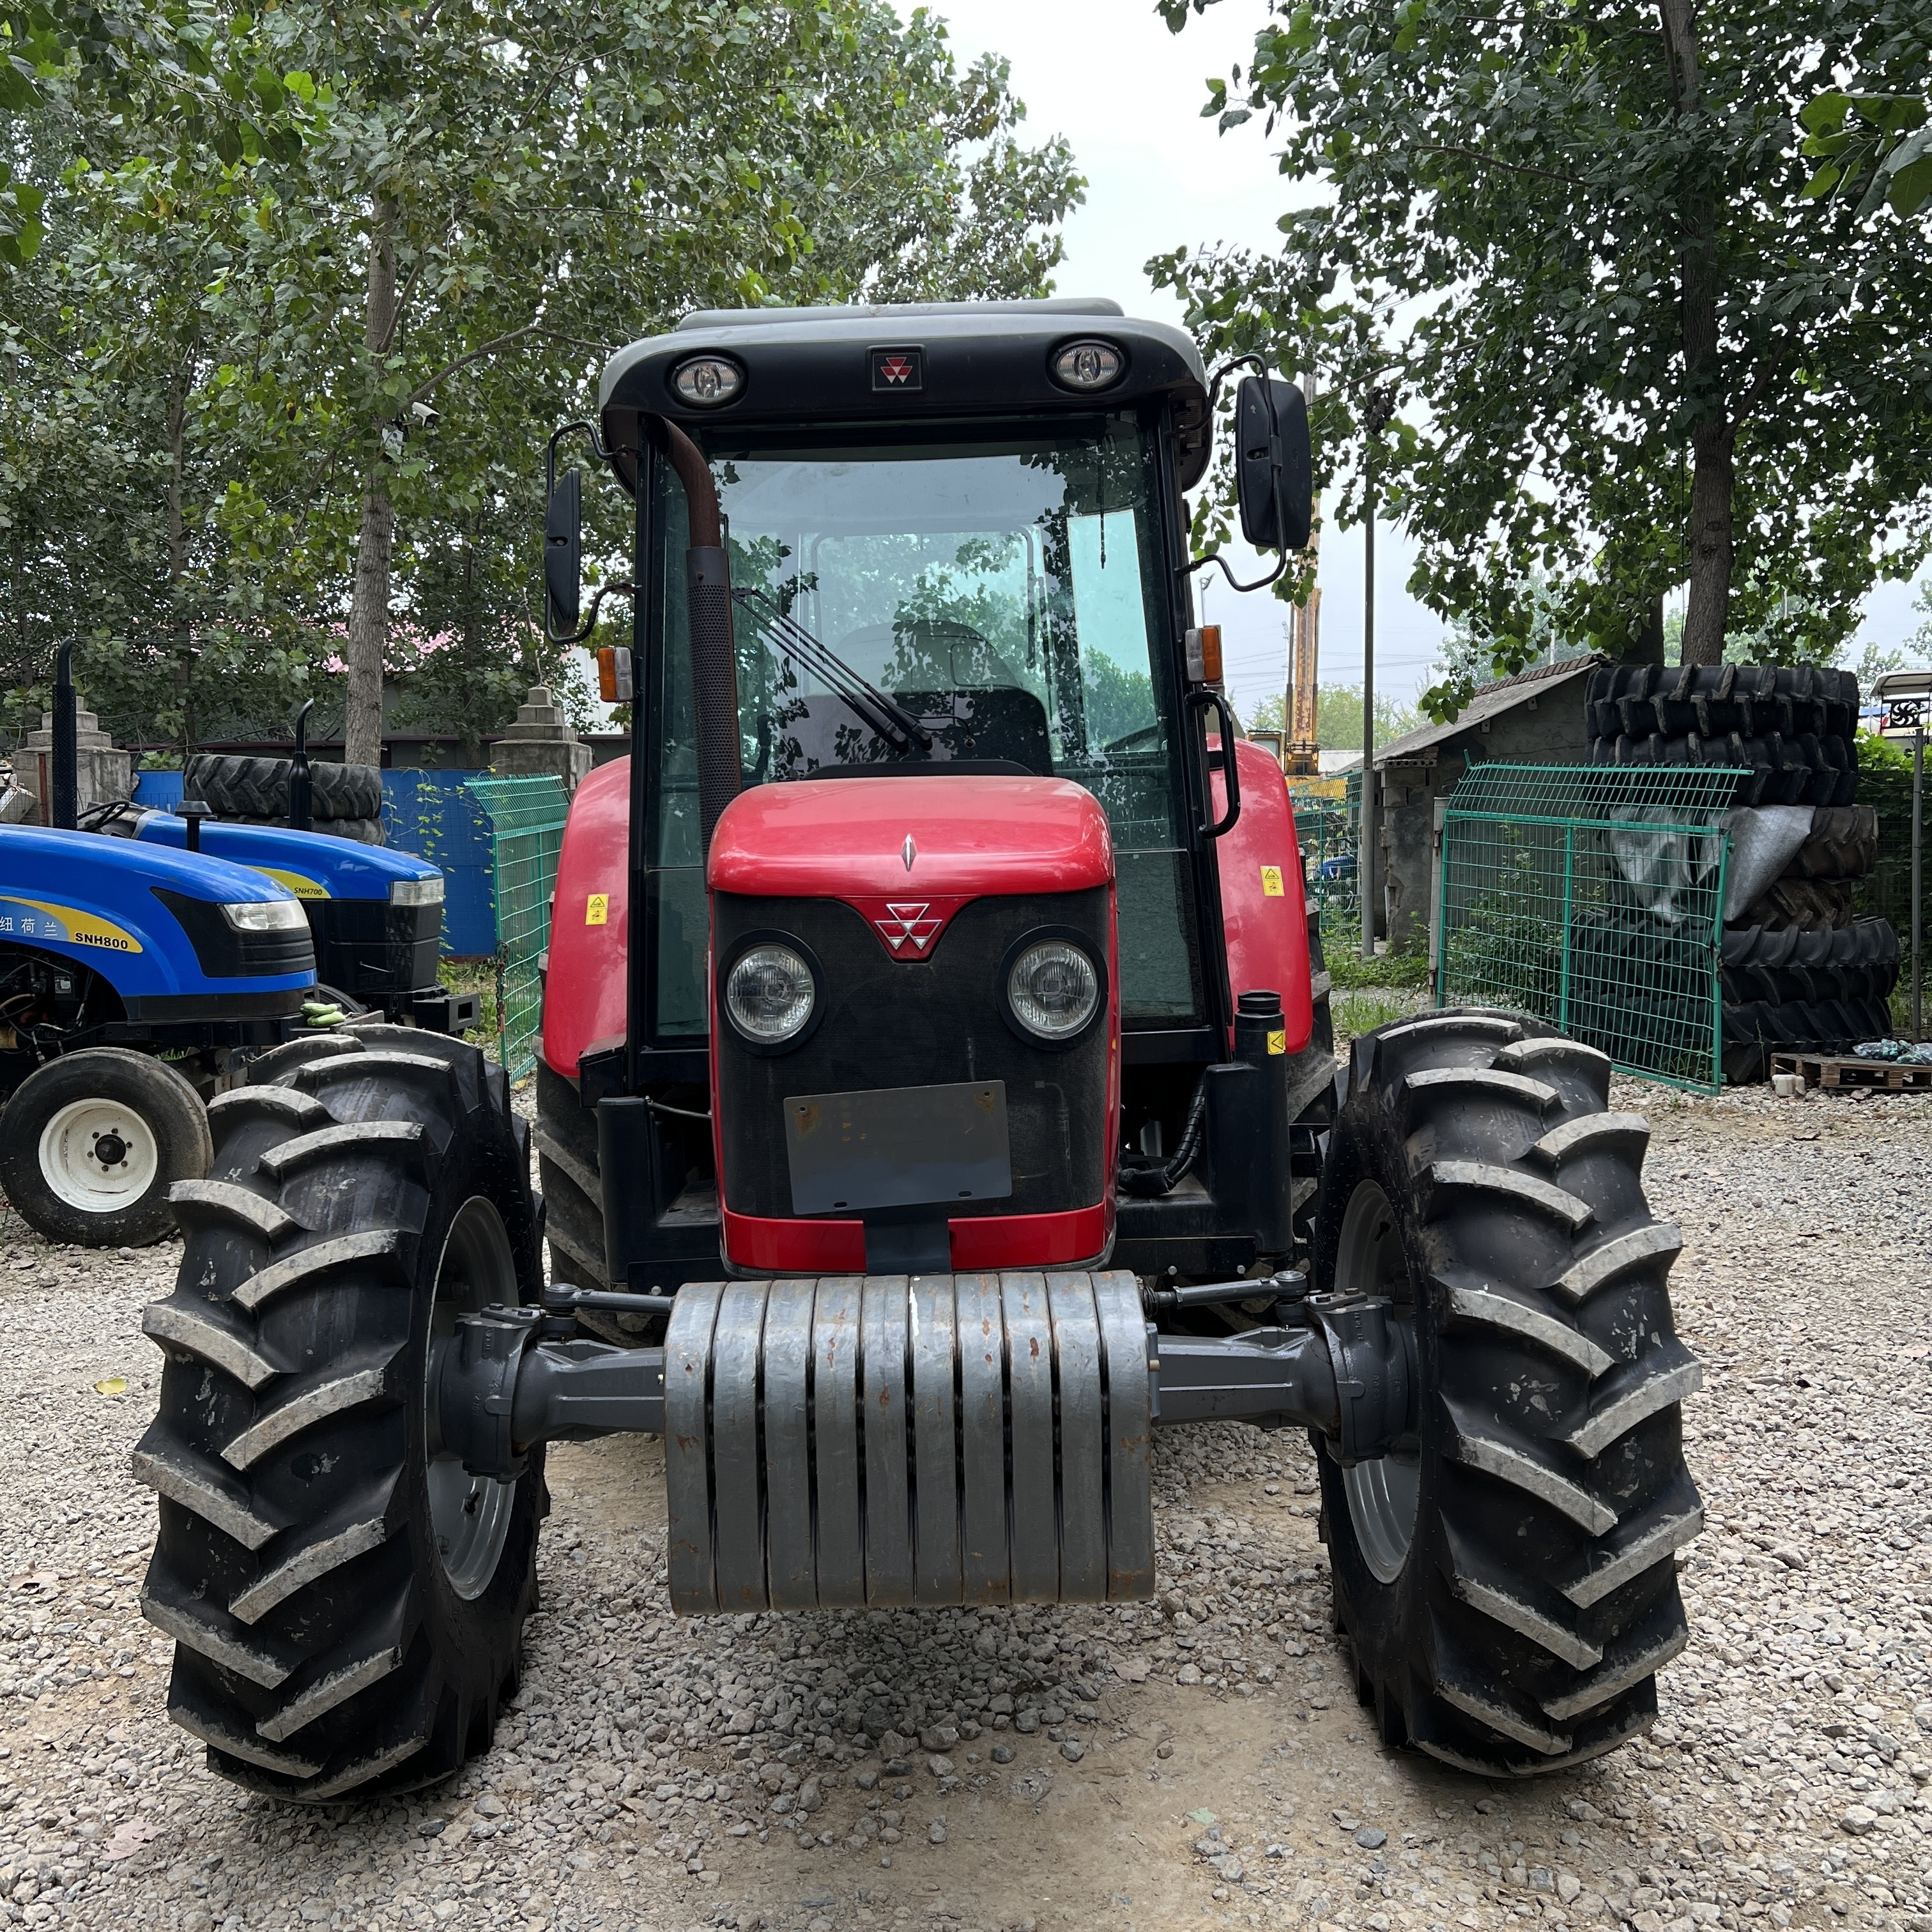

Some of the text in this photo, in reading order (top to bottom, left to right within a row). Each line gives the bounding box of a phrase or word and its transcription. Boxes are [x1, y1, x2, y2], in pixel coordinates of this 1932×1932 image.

[294, 887, 323, 896] SNH700
[0, 916, 58, 937] 纽荷兰
[75, 932, 128, 949] SNH800
